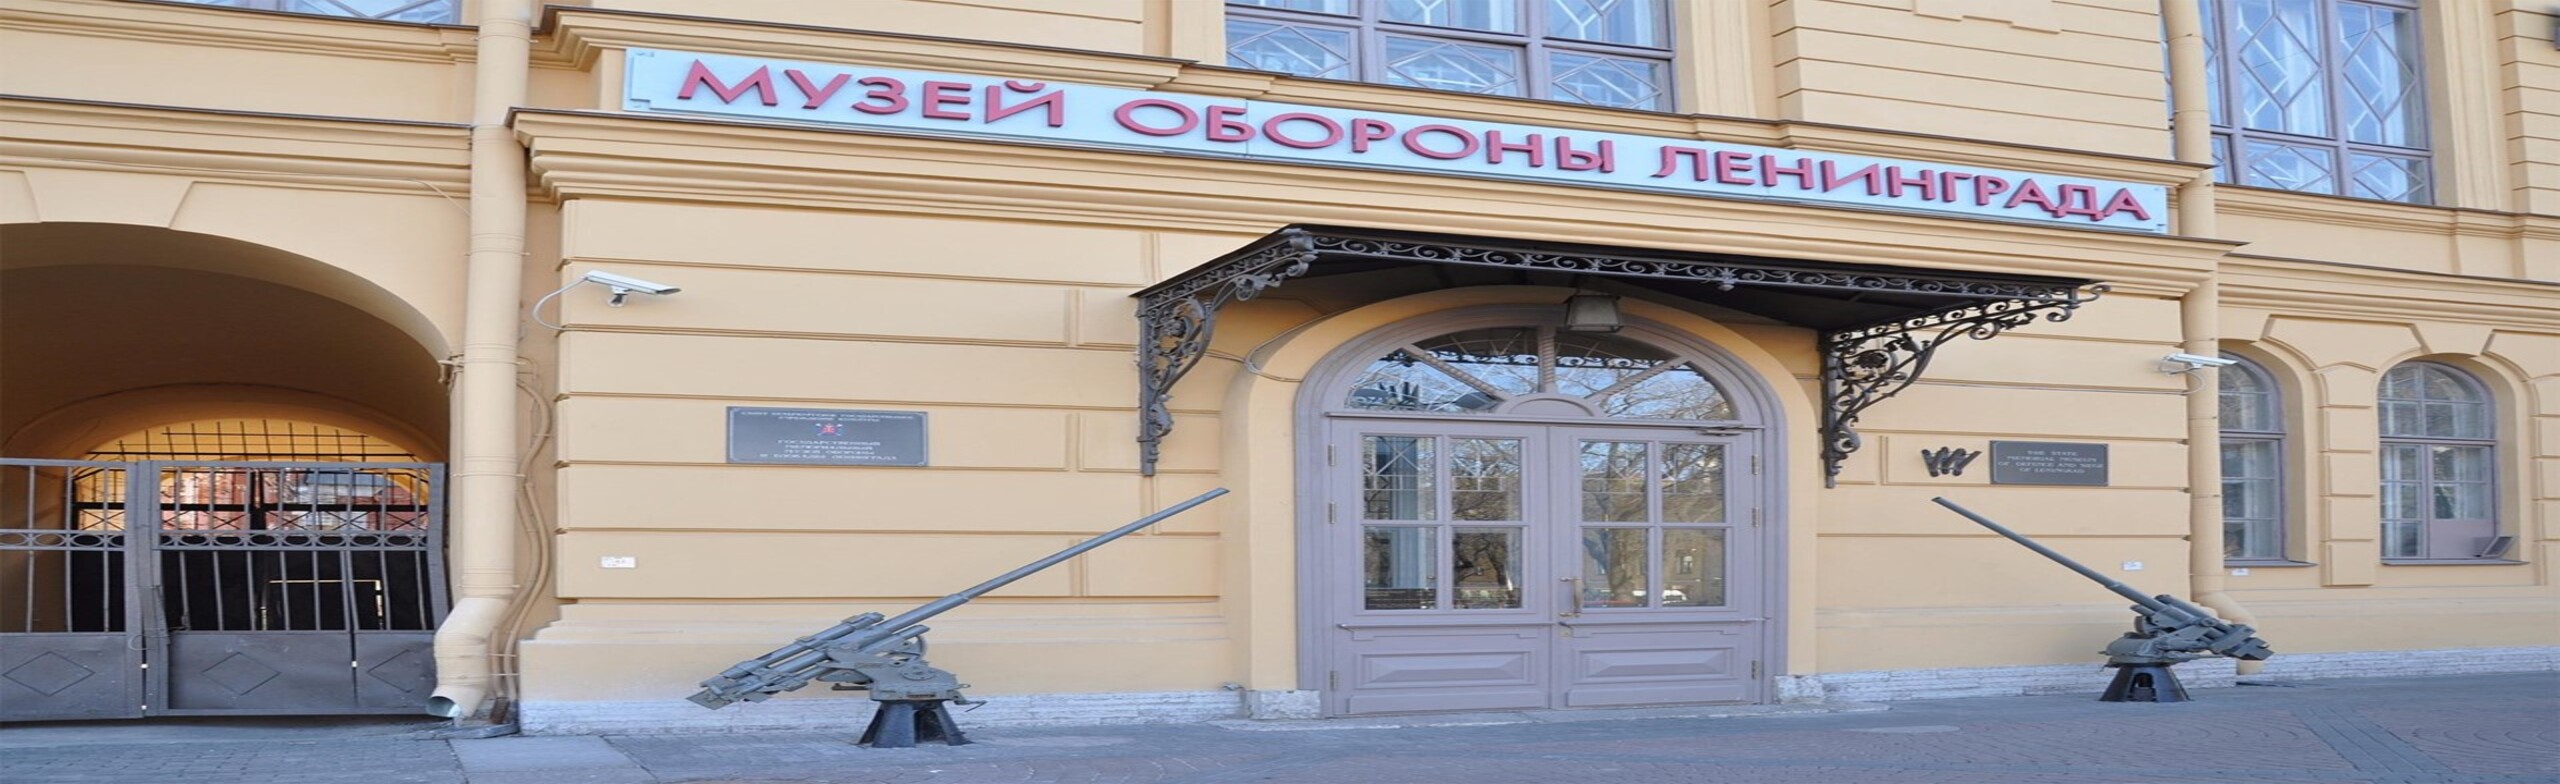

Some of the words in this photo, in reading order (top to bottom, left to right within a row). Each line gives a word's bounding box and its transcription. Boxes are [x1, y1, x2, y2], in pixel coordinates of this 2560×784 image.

[677, 59, 1065, 127] МУЗЕЙ
[1114, 98, 1615, 173] ОБОРОНЫ
[1651, 145, 2151, 222] ЛЕНИНГРАДА
